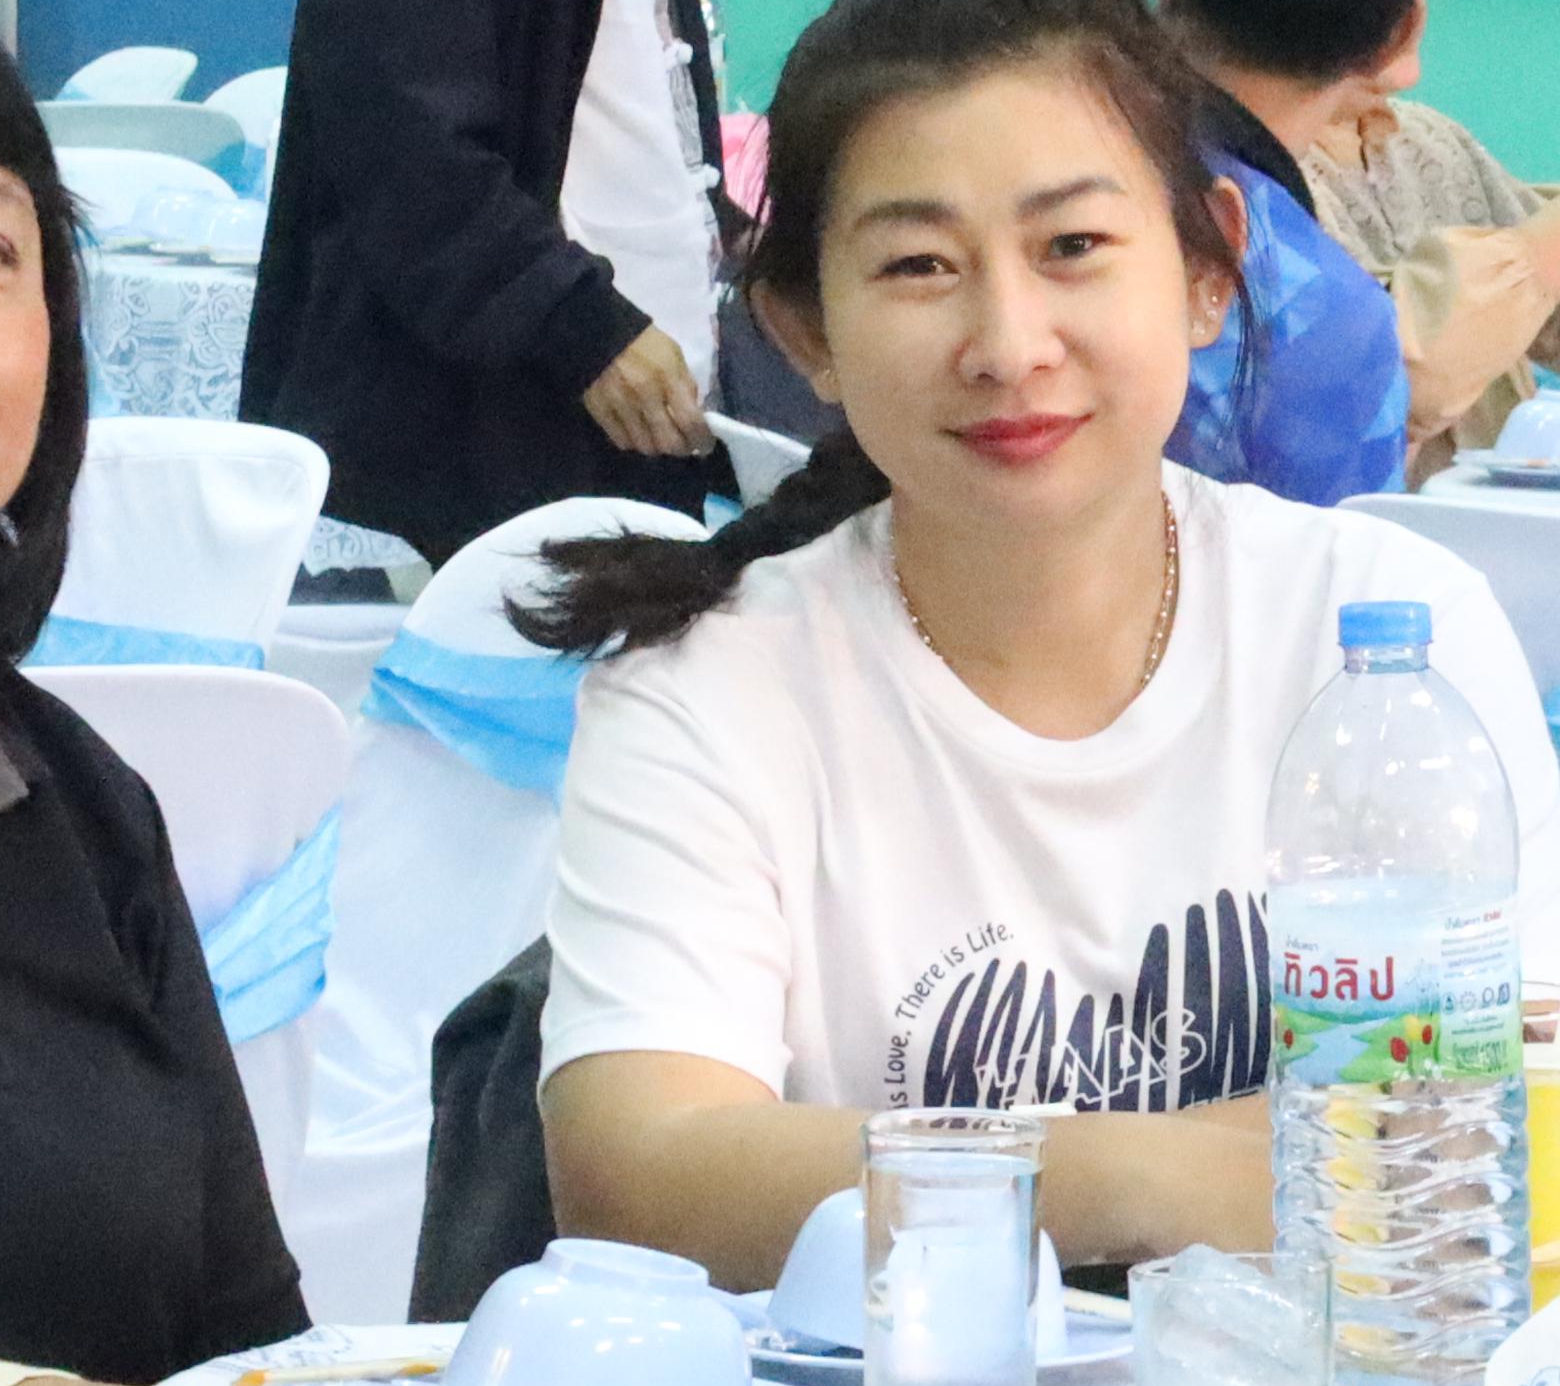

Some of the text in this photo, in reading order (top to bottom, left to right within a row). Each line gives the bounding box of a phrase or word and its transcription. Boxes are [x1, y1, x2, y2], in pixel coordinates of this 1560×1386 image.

[940, 945, 965, 968] is
[966, 922, 1014, 954] Life.
[895, 963, 946, 1020] There
[1283, 951, 1395, 1002] ทิวลิป
[884, 1030, 912, 1085] Love.
